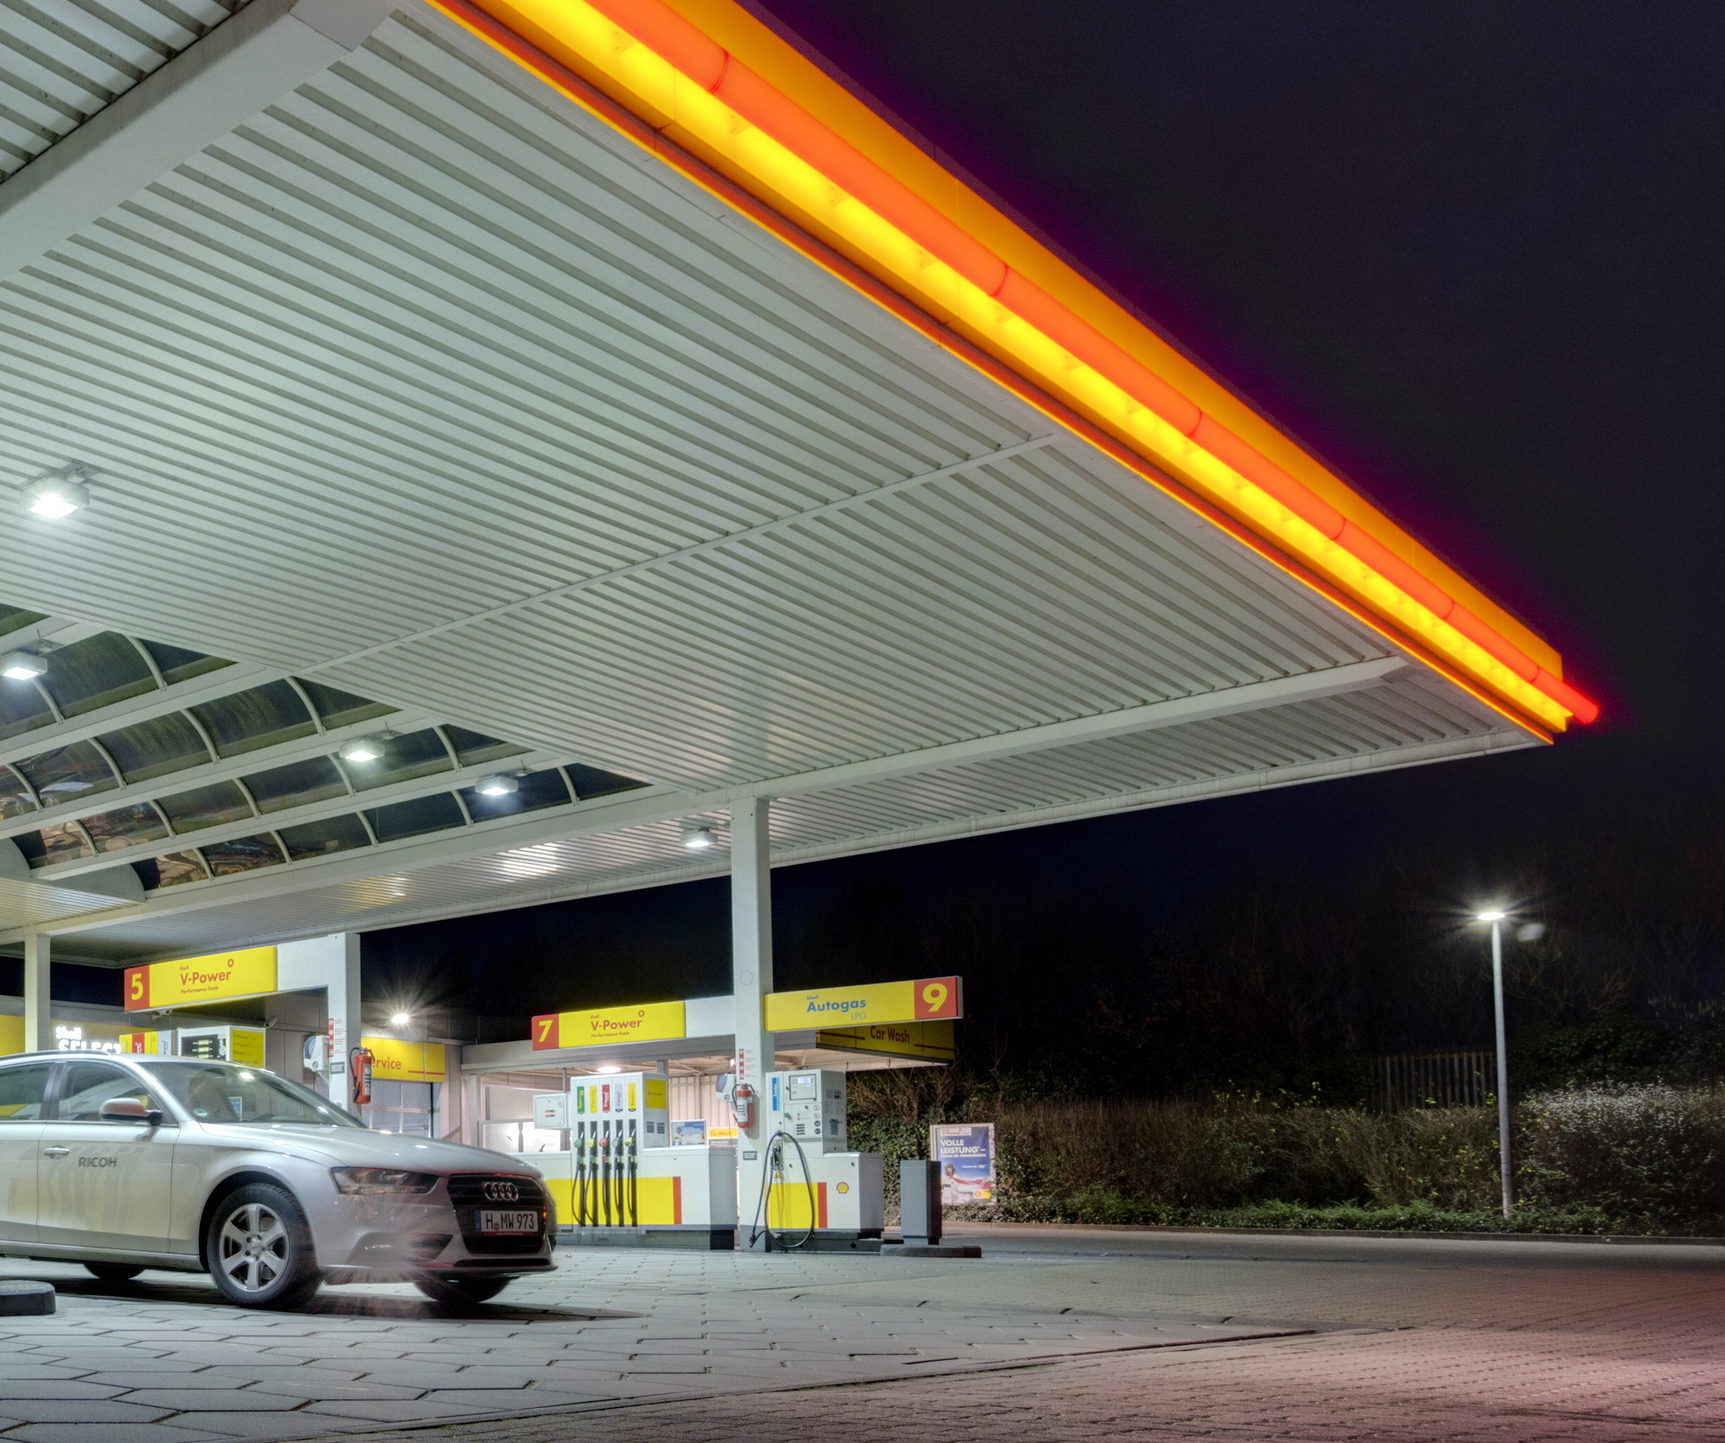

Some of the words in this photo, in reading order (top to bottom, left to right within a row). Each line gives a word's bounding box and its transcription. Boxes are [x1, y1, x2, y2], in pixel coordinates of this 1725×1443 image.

[180, 970, 232, 986] V-Power
[131, 973, 144, 1001] 5
[922, 982, 948, 1013] 9
[806, 998, 867, 1014] Autogas
[851, 1012, 867, 1021] LPG
[539, 1020, 554, 1043] 7
[591, 1019, 642, 1031] V-Power
[870, 1025, 885, 1040] Car
[887, 1028, 910, 1044] Wash
[371, 1056, 402, 1070] ervice
[940, 1139, 964, 1147] VOLLE
[78, 1157, 117, 1167] RICOH
[485, 1213, 493, 1229] H
[500, 1213, 514, 1229] MW
[516, 1213, 535, 1230] 973
